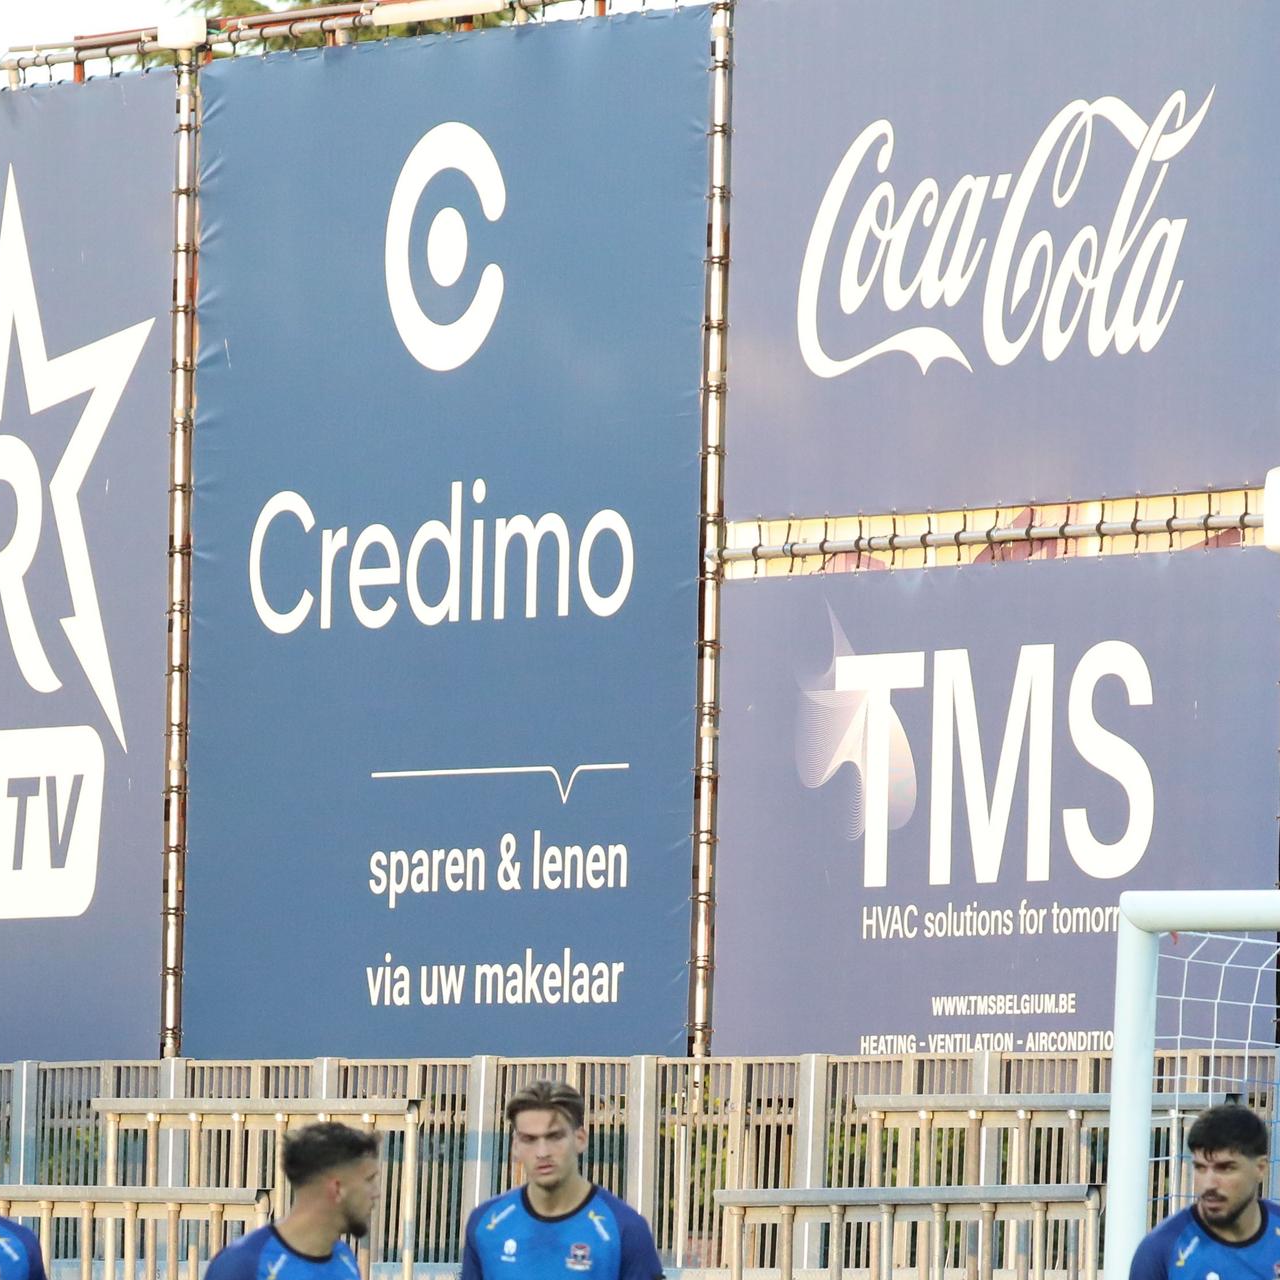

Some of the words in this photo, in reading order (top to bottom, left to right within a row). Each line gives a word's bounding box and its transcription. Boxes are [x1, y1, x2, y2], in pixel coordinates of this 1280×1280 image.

[797, 84, 1215, 378] Coca-Cola
[248, 478, 635, 634] Credimo
[835, 640, 1154, 888] TMS
[7, 774, 84, 871] TV
[368, 847, 486, 909] sparen
[496, 832, 522, 890] &
[532, 830, 629, 889] lenen
[862, 905, 918, 939] HVAC
[923, 902, 1014, 938] solutions
[1018, 899, 1048, 934] for
[1052, 902, 1120, 934] tomorr
[366, 953, 411, 1006] via
[420, 963, 466, 1005] uw
[474, 947, 625, 1004] makelaar
[931, 993, 1076, 1016] WWW.TMSBELGIUM.BE
[860, 1035, 917, 1054] HEATING
[928, 1032, 1014, 1052] VENTILATION
[1025, 1030, 1113, 1051] AIRCONDITIO
